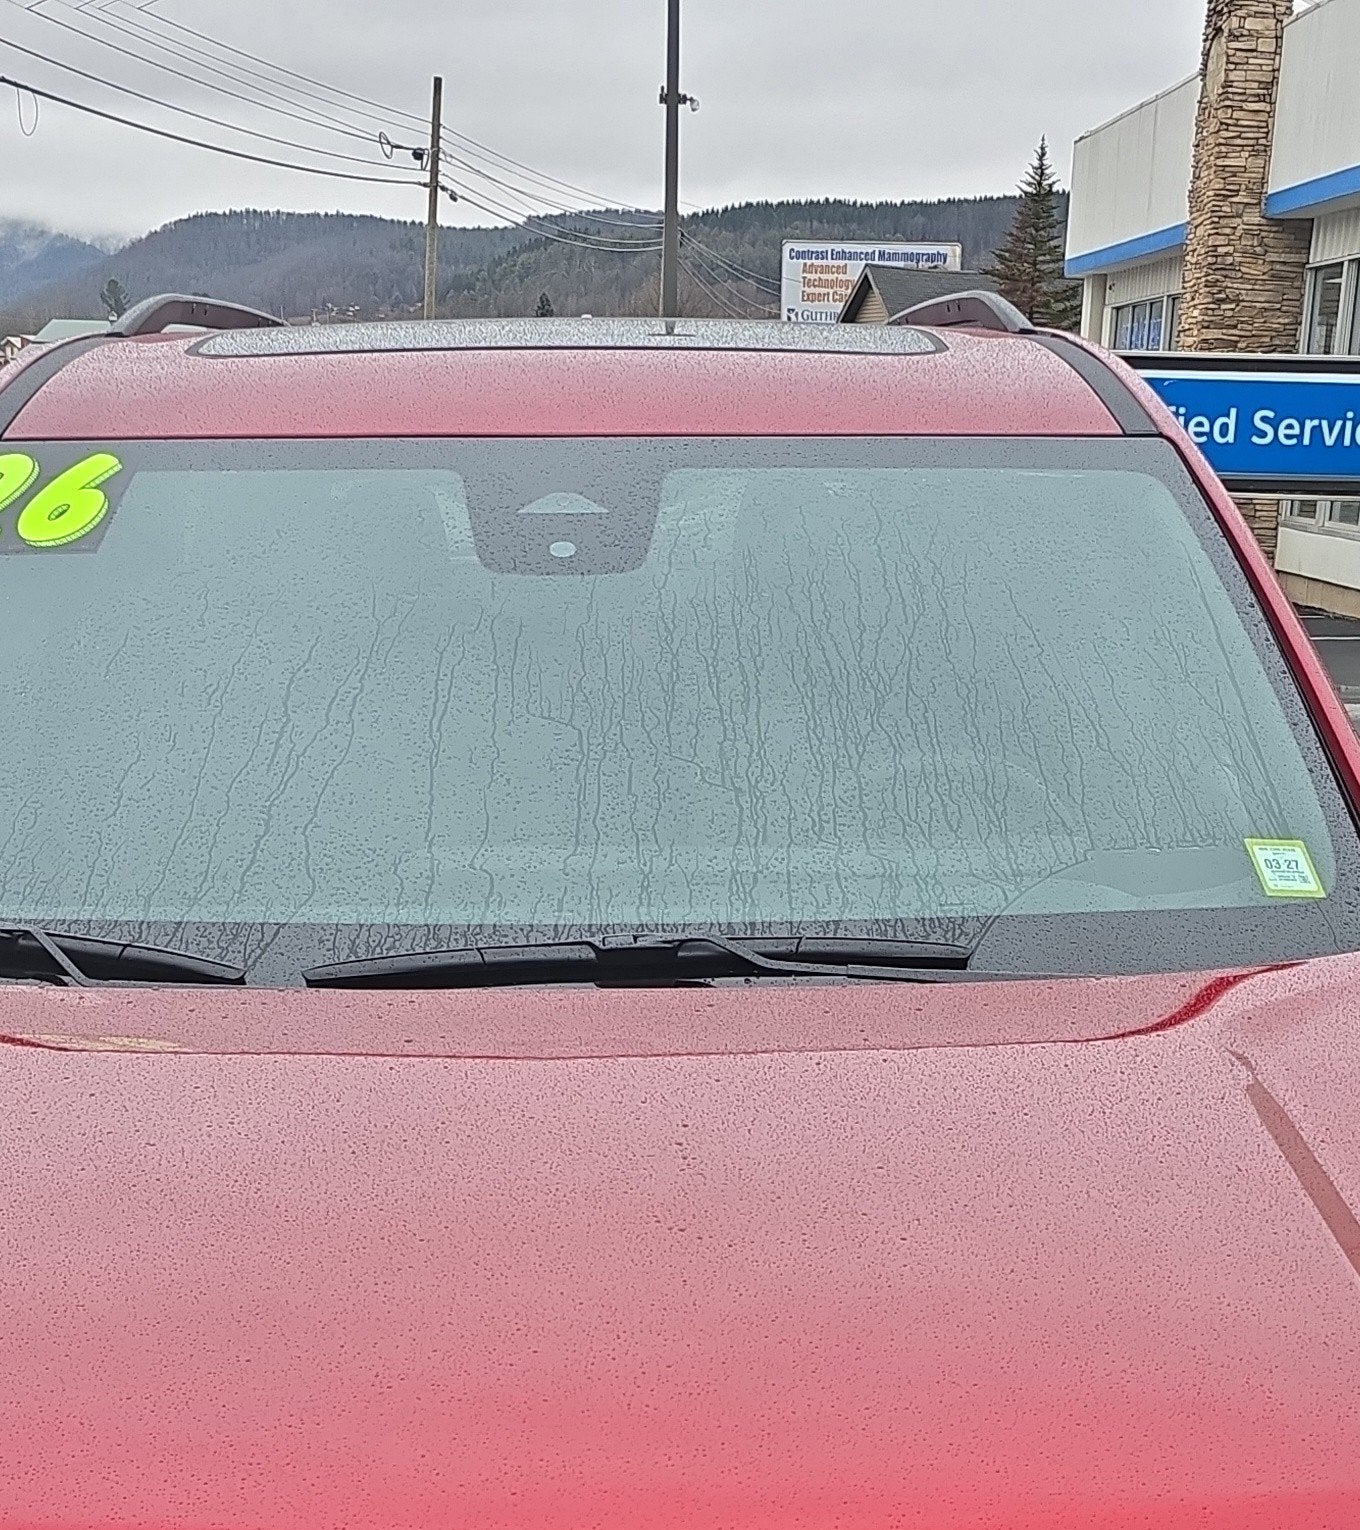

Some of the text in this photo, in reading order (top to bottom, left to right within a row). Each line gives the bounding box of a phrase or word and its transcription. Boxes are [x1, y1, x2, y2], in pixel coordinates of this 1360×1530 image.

[788, 247, 948, 265] Contrast Enhanced Mammography
[801, 262, 848, 275] Advanced
[801, 289, 830, 303] Expert
[1264, 858, 1299, 870] 03 27
